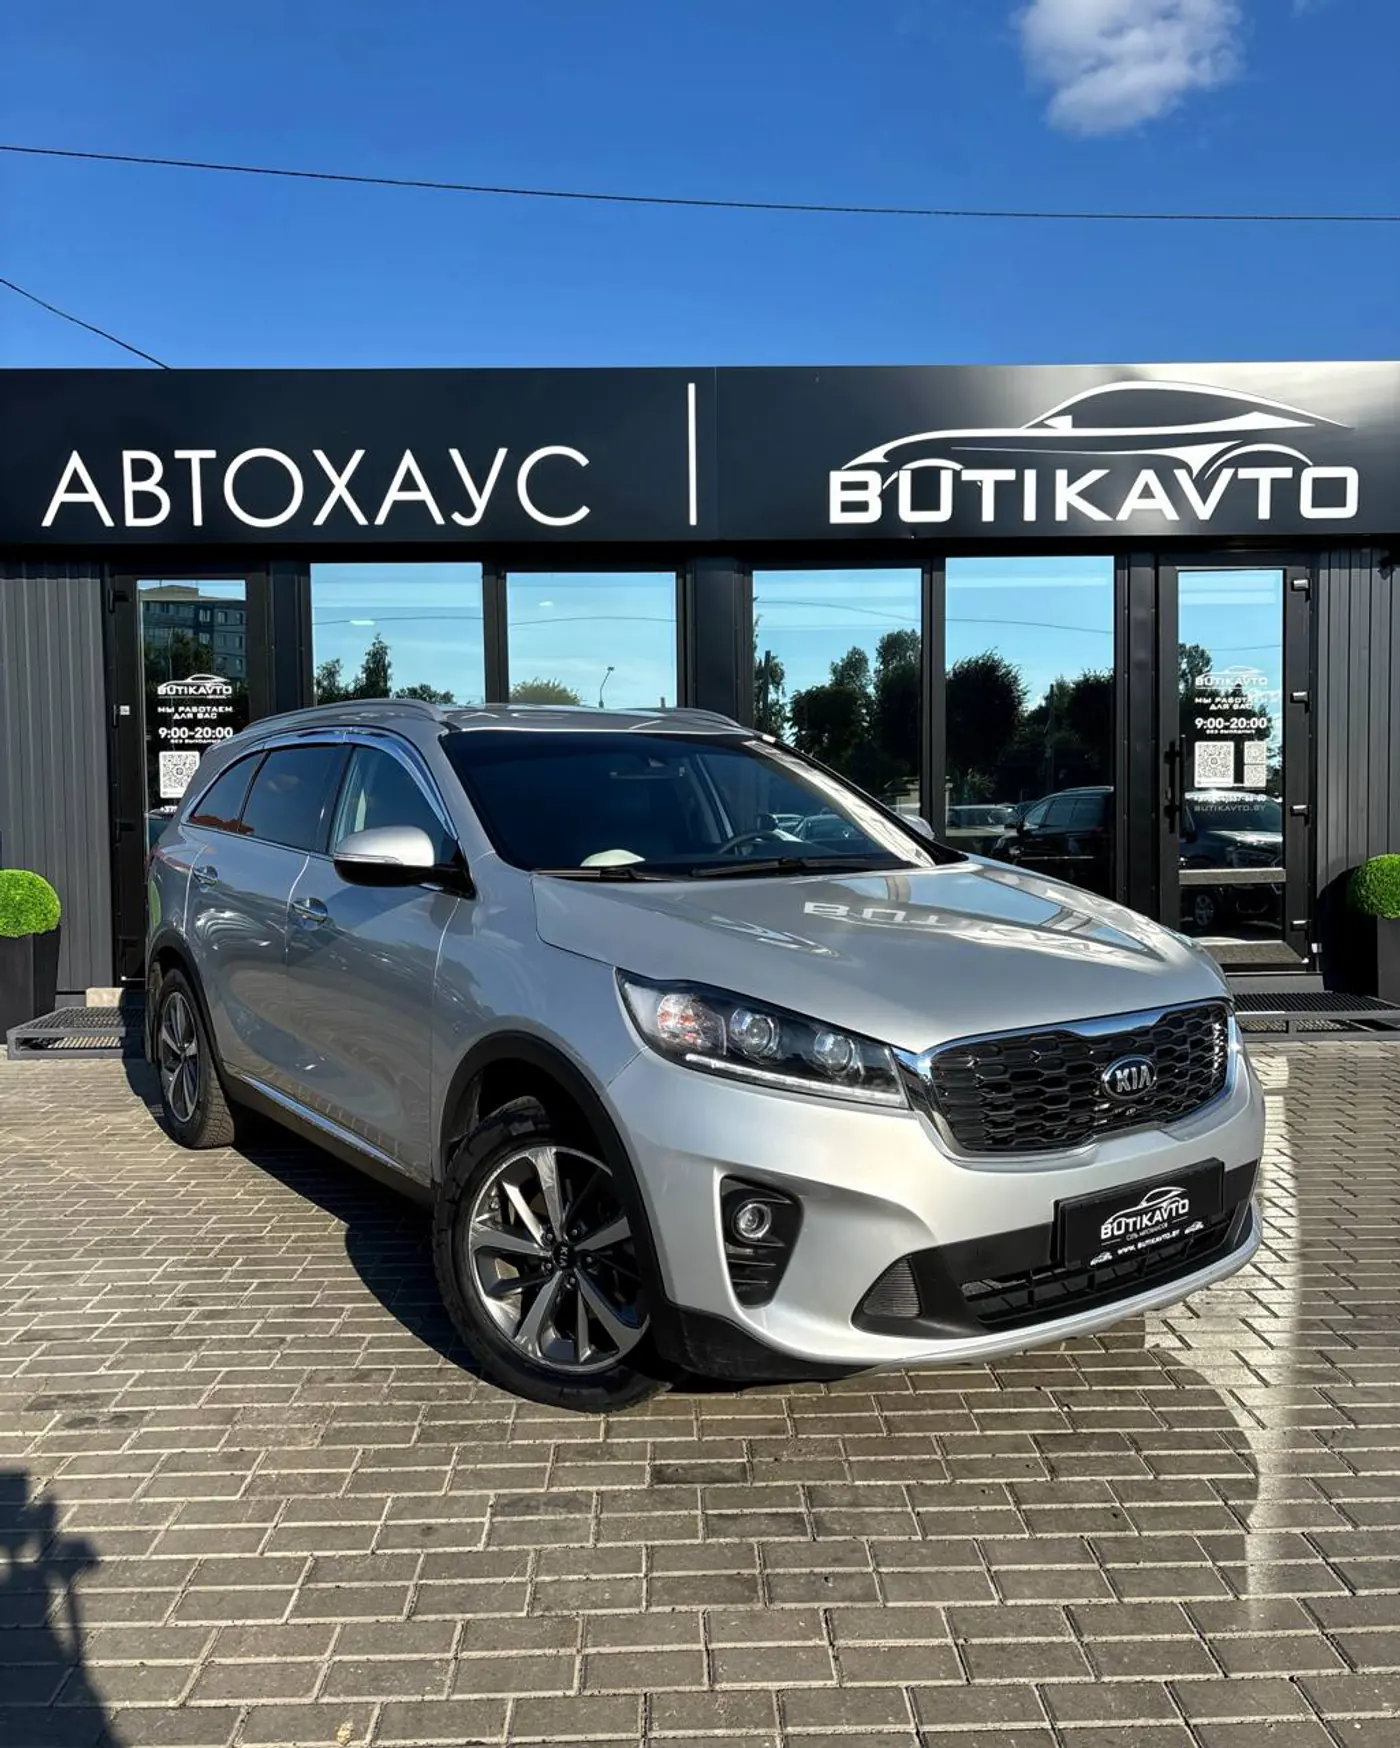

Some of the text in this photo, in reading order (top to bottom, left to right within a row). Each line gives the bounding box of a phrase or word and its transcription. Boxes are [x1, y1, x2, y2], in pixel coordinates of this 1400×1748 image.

[41, 445, 591, 528] АВТОХАУС
[829, 466, 1359, 524] BUTIKAVTO
[157, 685, 232, 695] BUTIKAVTO
[158, 727, 234, 739] 9:00-20:00
[1194, 717, 1268, 729] 9:00-20:00
[1115, 1064, 1151, 1093] KIA
[1100, 1198, 1189, 1240] BUTIKAVTO
